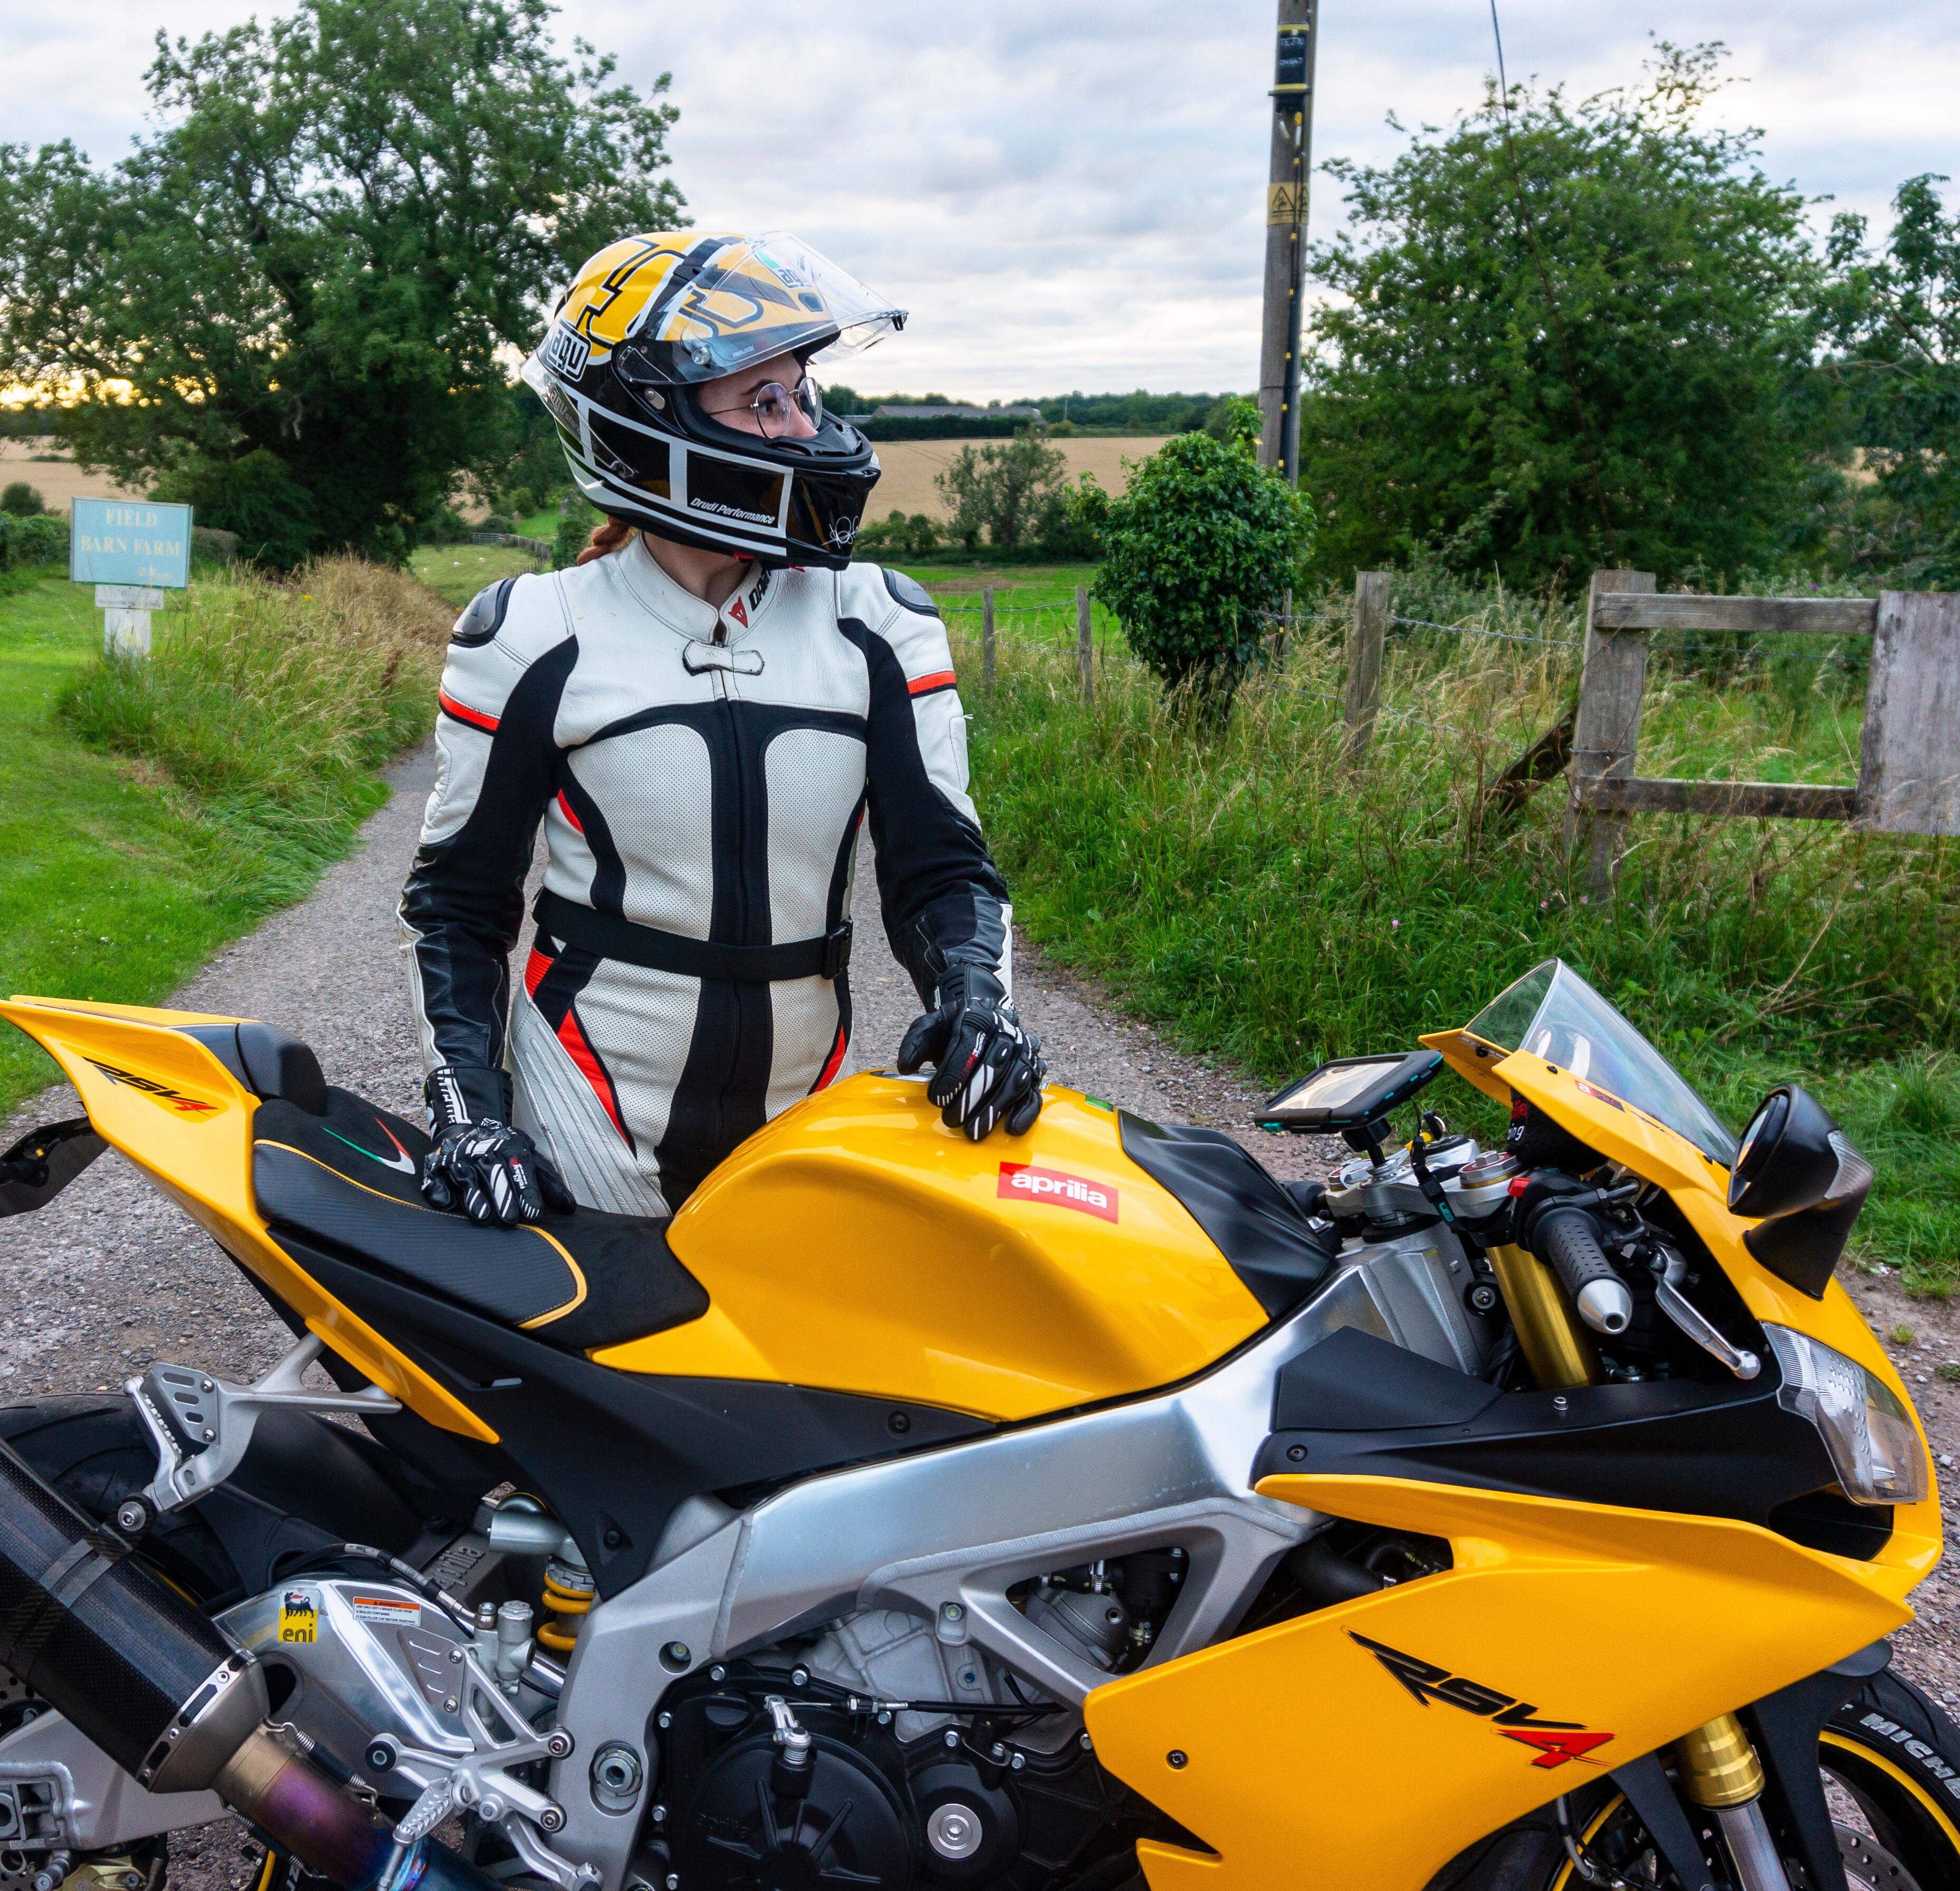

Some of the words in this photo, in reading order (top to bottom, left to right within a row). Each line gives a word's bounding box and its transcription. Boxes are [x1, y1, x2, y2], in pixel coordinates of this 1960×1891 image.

[106, 508, 158, 527] FIELD
[690, 498, 719, 511] Drudi
[717, 504, 775, 524] Performance
[81, 534, 127, 553] BARN
[134, 538, 180, 557] FARM
[1011, 1173, 1108, 1209] aprilia
[282, 1623, 313, 1642] eni
